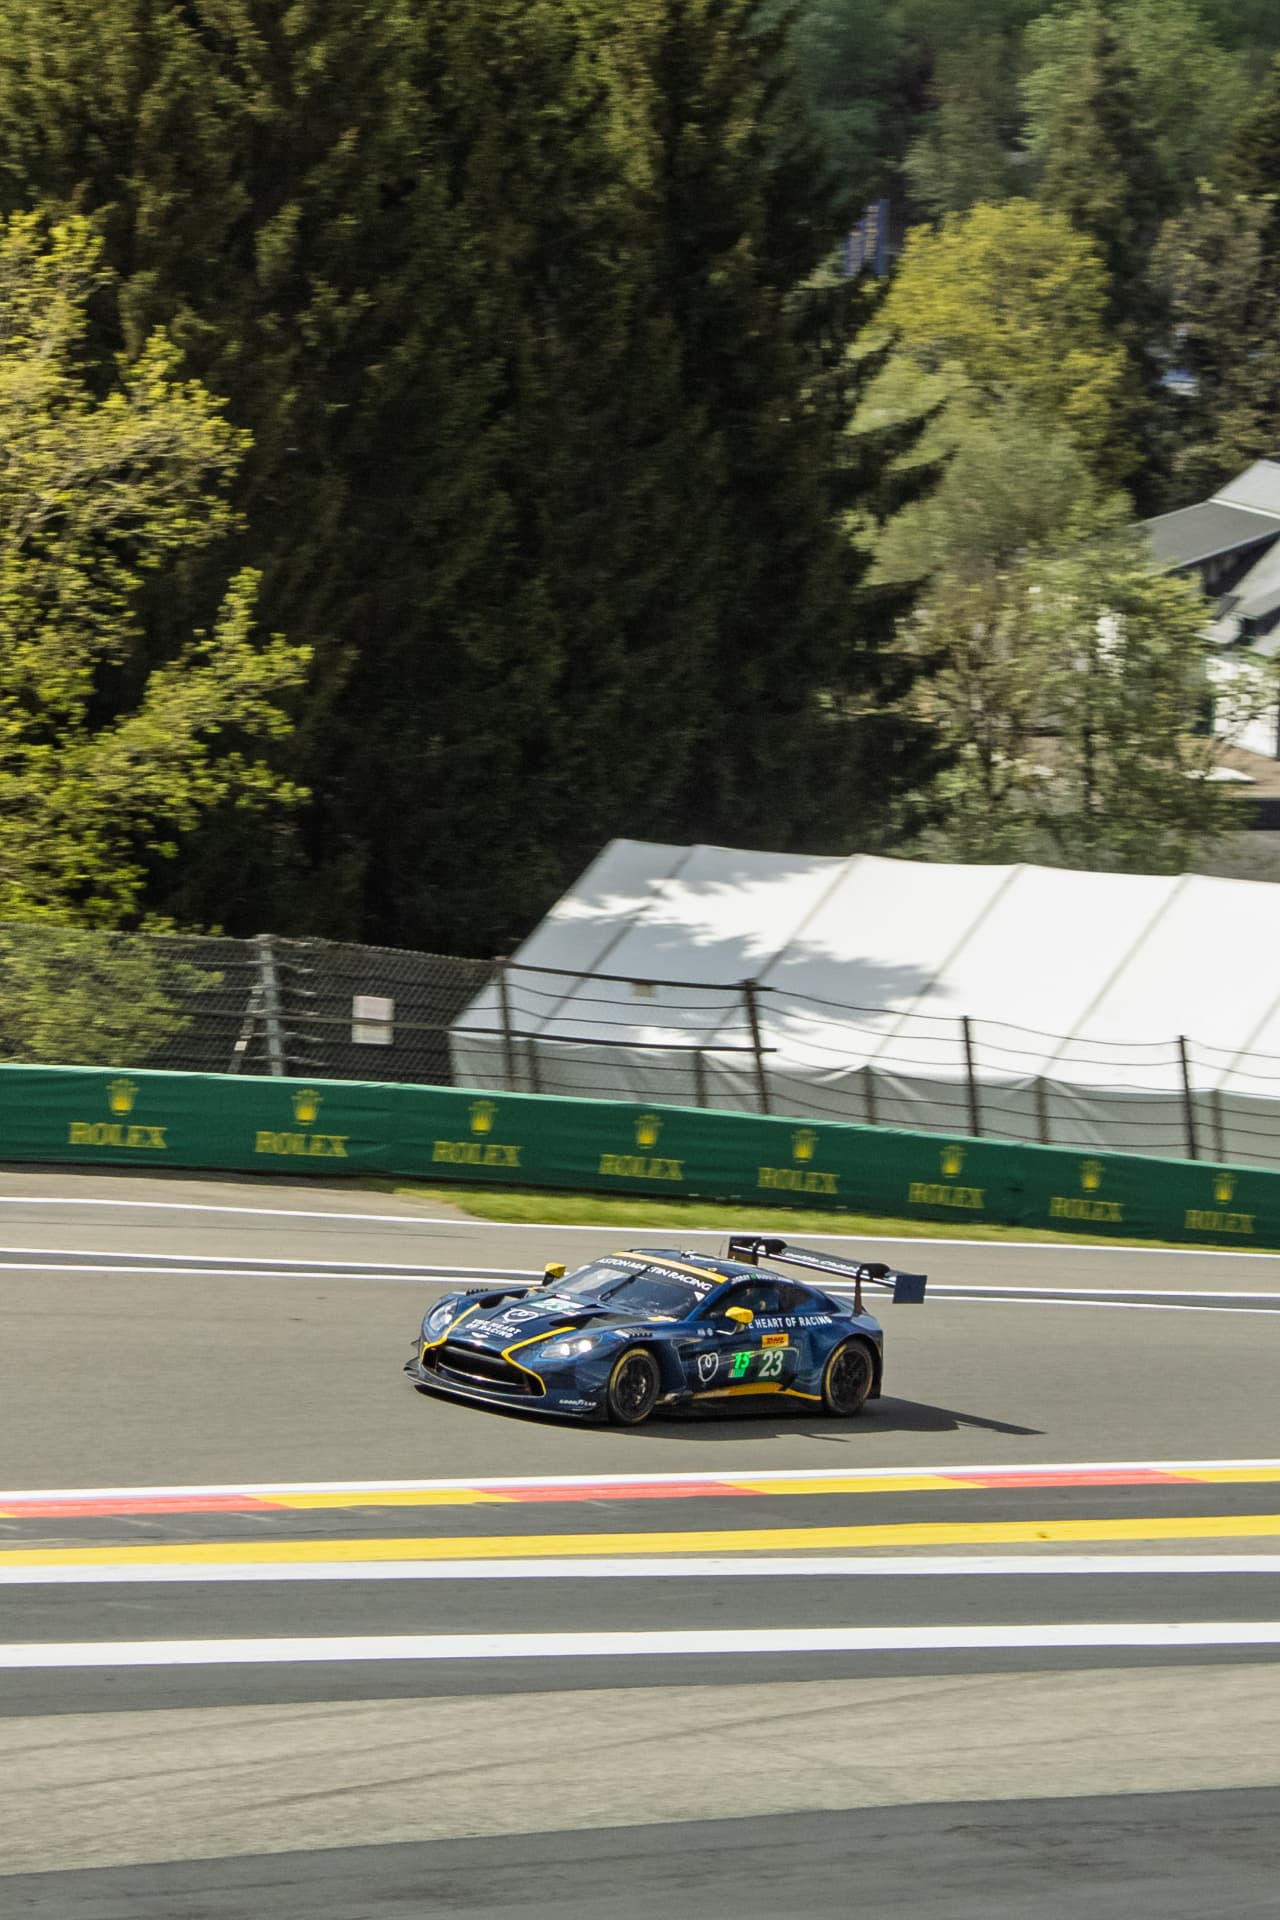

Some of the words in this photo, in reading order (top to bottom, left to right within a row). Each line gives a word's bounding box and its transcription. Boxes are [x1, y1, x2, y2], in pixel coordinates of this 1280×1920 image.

[68, 1121, 167, 1149] ROLEX
[255, 1131, 348, 1158] ROLEX
[432, 1141, 521, 1167] ROLEX
[599, 1153, 684, 1181] ROLEX
[758, 1167, 839, 1194] ROLEX
[908, 1181, 985, 1209] ROLEX
[1049, 1195, 1123, 1223] ROLEX
[1185, 1208, 1255, 1234] ROLEX
[596, 1258, 629, 1267] ASTON
[667, 1271, 713, 1291] RACING
[478, 1325, 514, 1338] RACING
[754, 1317, 783, 1329] HEART
[785, 1316, 797, 1327] OF
[798, 1315, 833, 1327] RACING
[758, 1350, 784, 1377] 23
